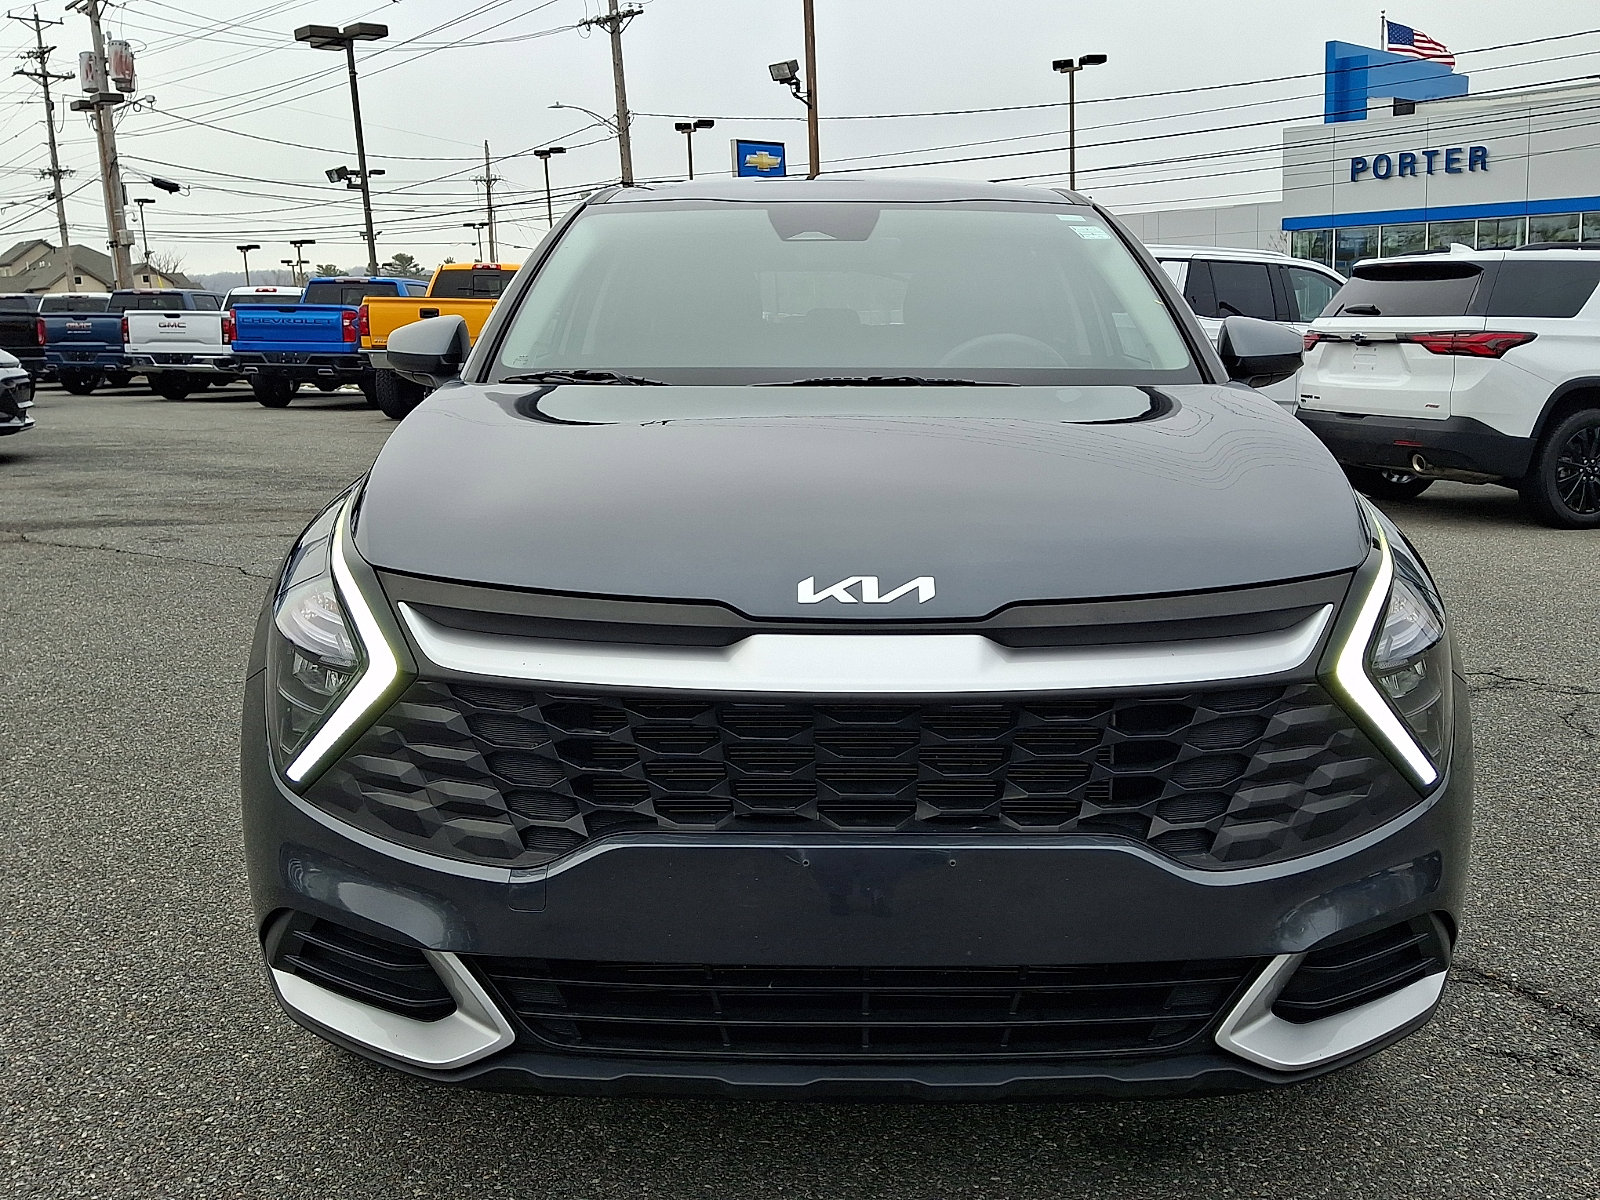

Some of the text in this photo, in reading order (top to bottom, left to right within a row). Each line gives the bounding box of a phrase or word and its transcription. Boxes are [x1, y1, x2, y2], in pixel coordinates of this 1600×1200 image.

[1351, 146, 1488, 182] PORTER
[241, 317, 332, 325] CHEVROLET
[797, 575, 936, 604] KIA
